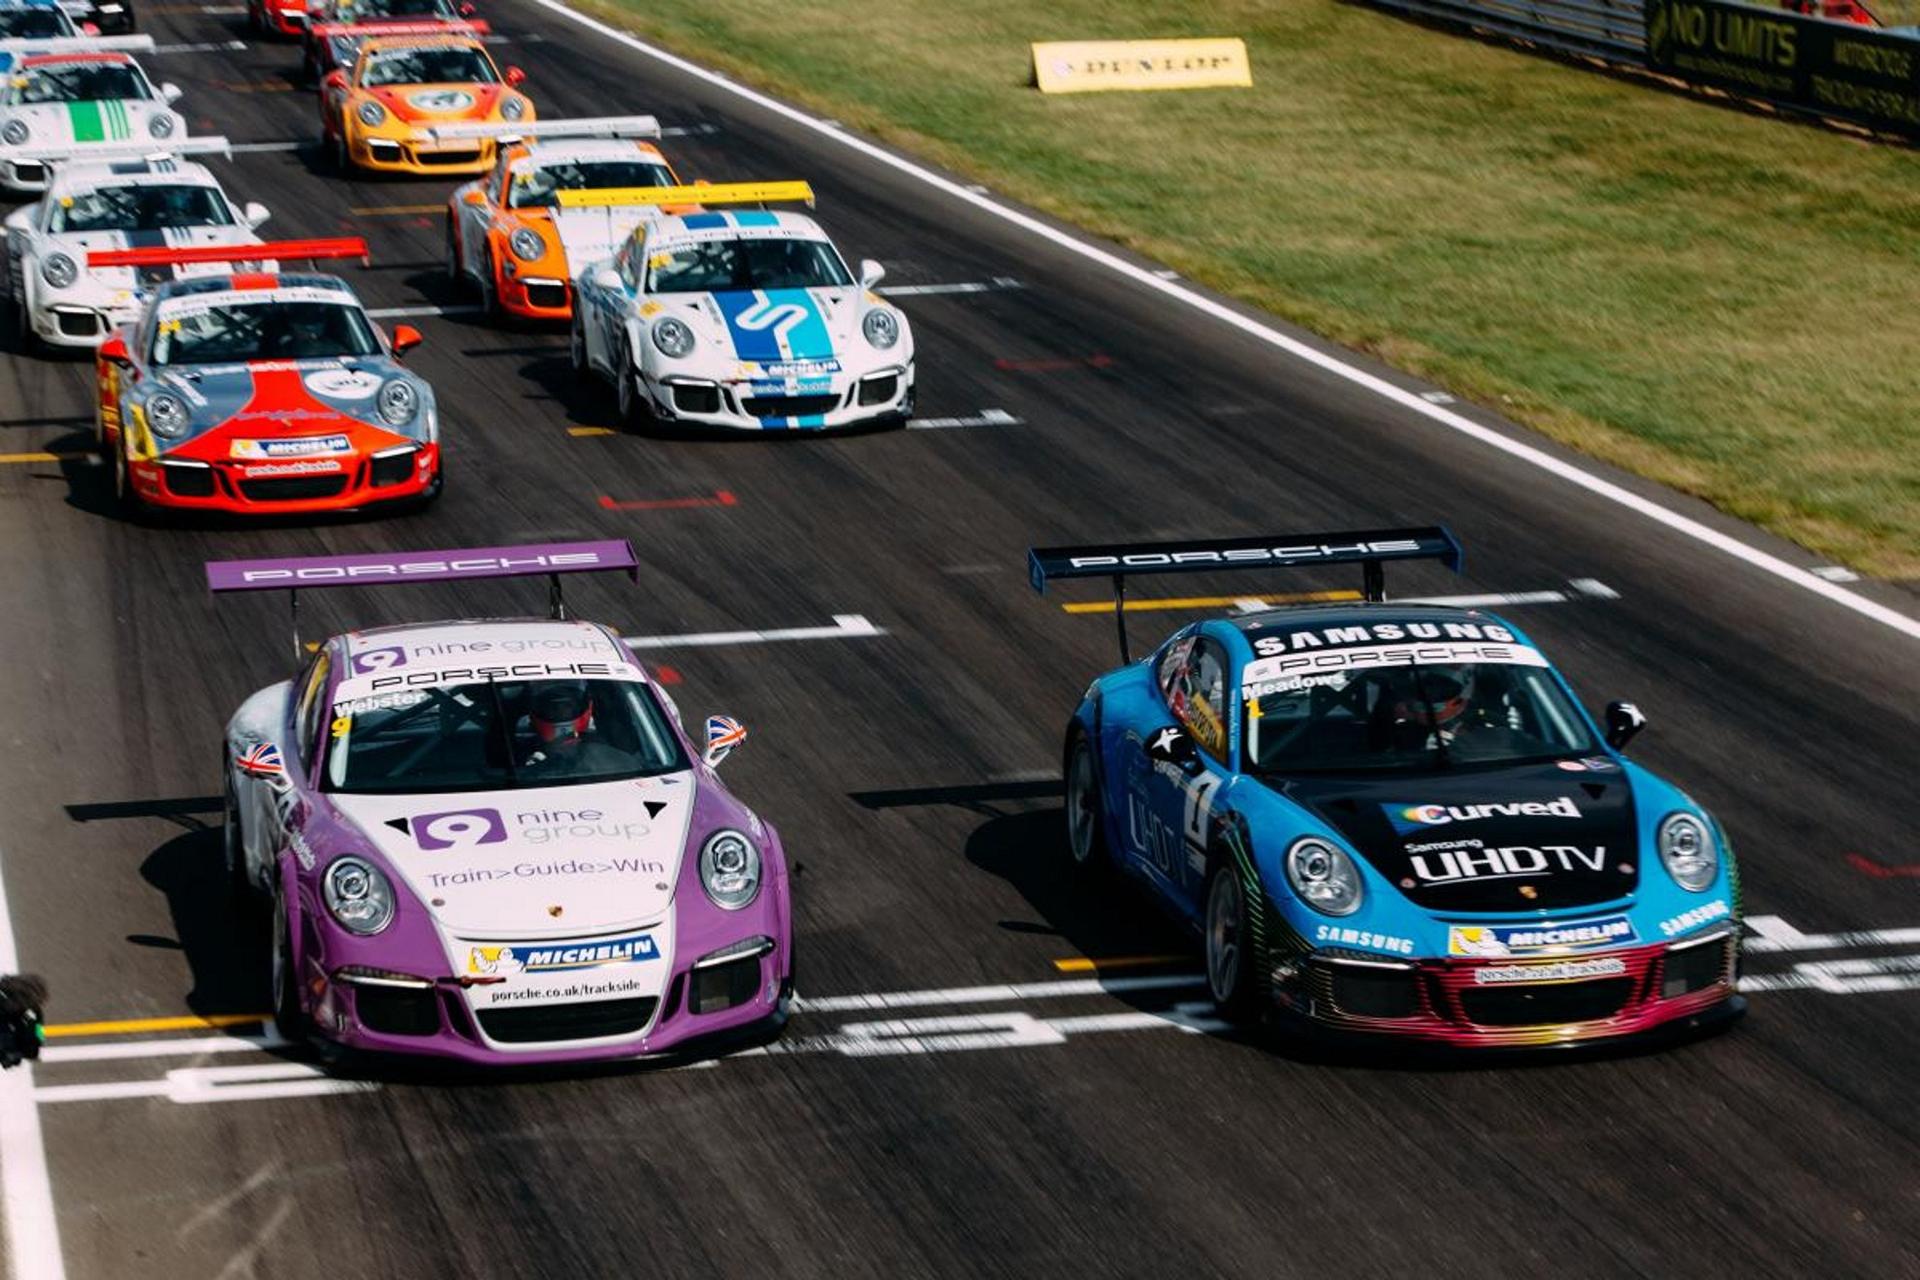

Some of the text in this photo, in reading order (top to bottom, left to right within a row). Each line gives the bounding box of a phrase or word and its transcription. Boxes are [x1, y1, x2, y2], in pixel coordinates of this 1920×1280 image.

[1671, 3, 1797, 67] NO LIMITS
[243, 552, 599, 581] PORSCHE
[1070, 539, 1420, 568] PORSCHE
[415, 639, 493, 658] nine
[1254, 623, 1515, 656] SAMSUNG
[1281, 647, 1513, 672] PORSCHE
[372, 663, 610, 690] PORSCHE
[1242, 670, 1348, 700] Meadows
[333, 690, 426, 717] Webster
[331, 715, 352, 738] 9
[516, 807, 602, 825] nine
[1412, 797, 1583, 825] Curved
[523, 821, 651, 844] group
[1405, 838, 1484, 853] Samsung
[1660, 899, 1729, 937] SAMSUNG
[1316, 925, 1414, 954] SAMSUNG
[1508, 921, 1630, 947] MICHELIN
[525, 939, 652, 966] MICHELIN
[491, 979, 641, 1003] porsche.co.uk/trackside
